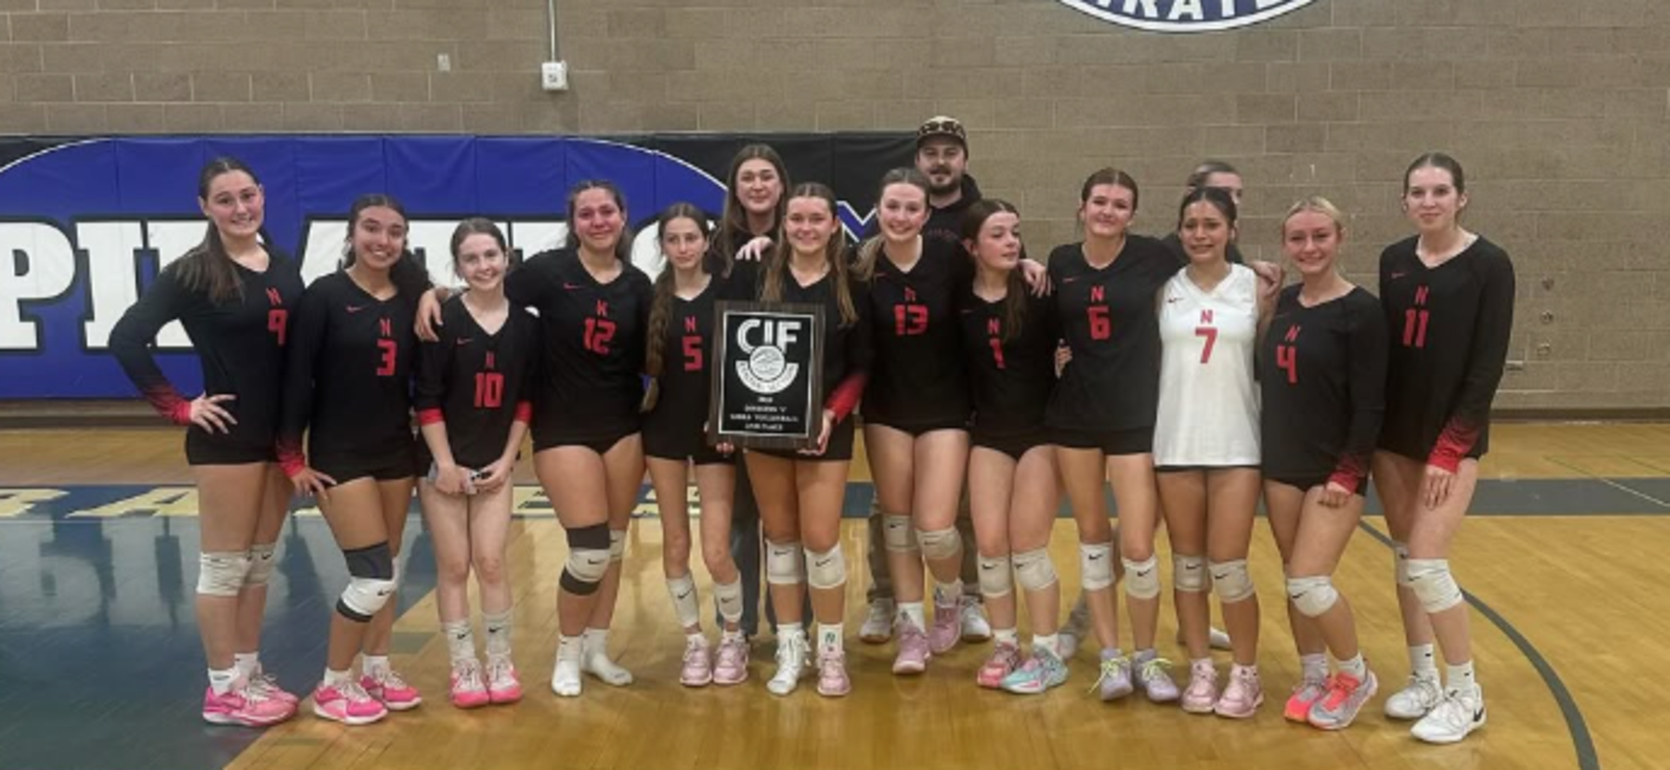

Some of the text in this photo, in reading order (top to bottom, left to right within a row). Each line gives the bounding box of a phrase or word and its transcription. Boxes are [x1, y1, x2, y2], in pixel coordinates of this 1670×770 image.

[266, 288, 282, 305] N
[1091, 286, 1105, 302] N
[1415, 285, 1429, 305] N
[268, 309, 288, 346] 9
[379, 319, 391, 335] N
[685, 317, 696, 332] N
[895, 304, 929, 335] 13
[987, 318, 1000, 335] N
[1087, 306, 1111, 340] 6
[1200, 310, 1213, 324] N
[1286, 325, 1301, 342] N
[1403, 309, 1429, 347] 11
[584, 317, 617, 354] 12
[737, 318, 802, 355] CIF
[1195, 327, 1218, 364] 7
[377, 339, 397, 376] 3
[683, 335, 703, 371] 5
[989, 337, 1005, 369] 1
[1276, 345, 1297, 384] 4
[474, 371, 505, 408] 10
